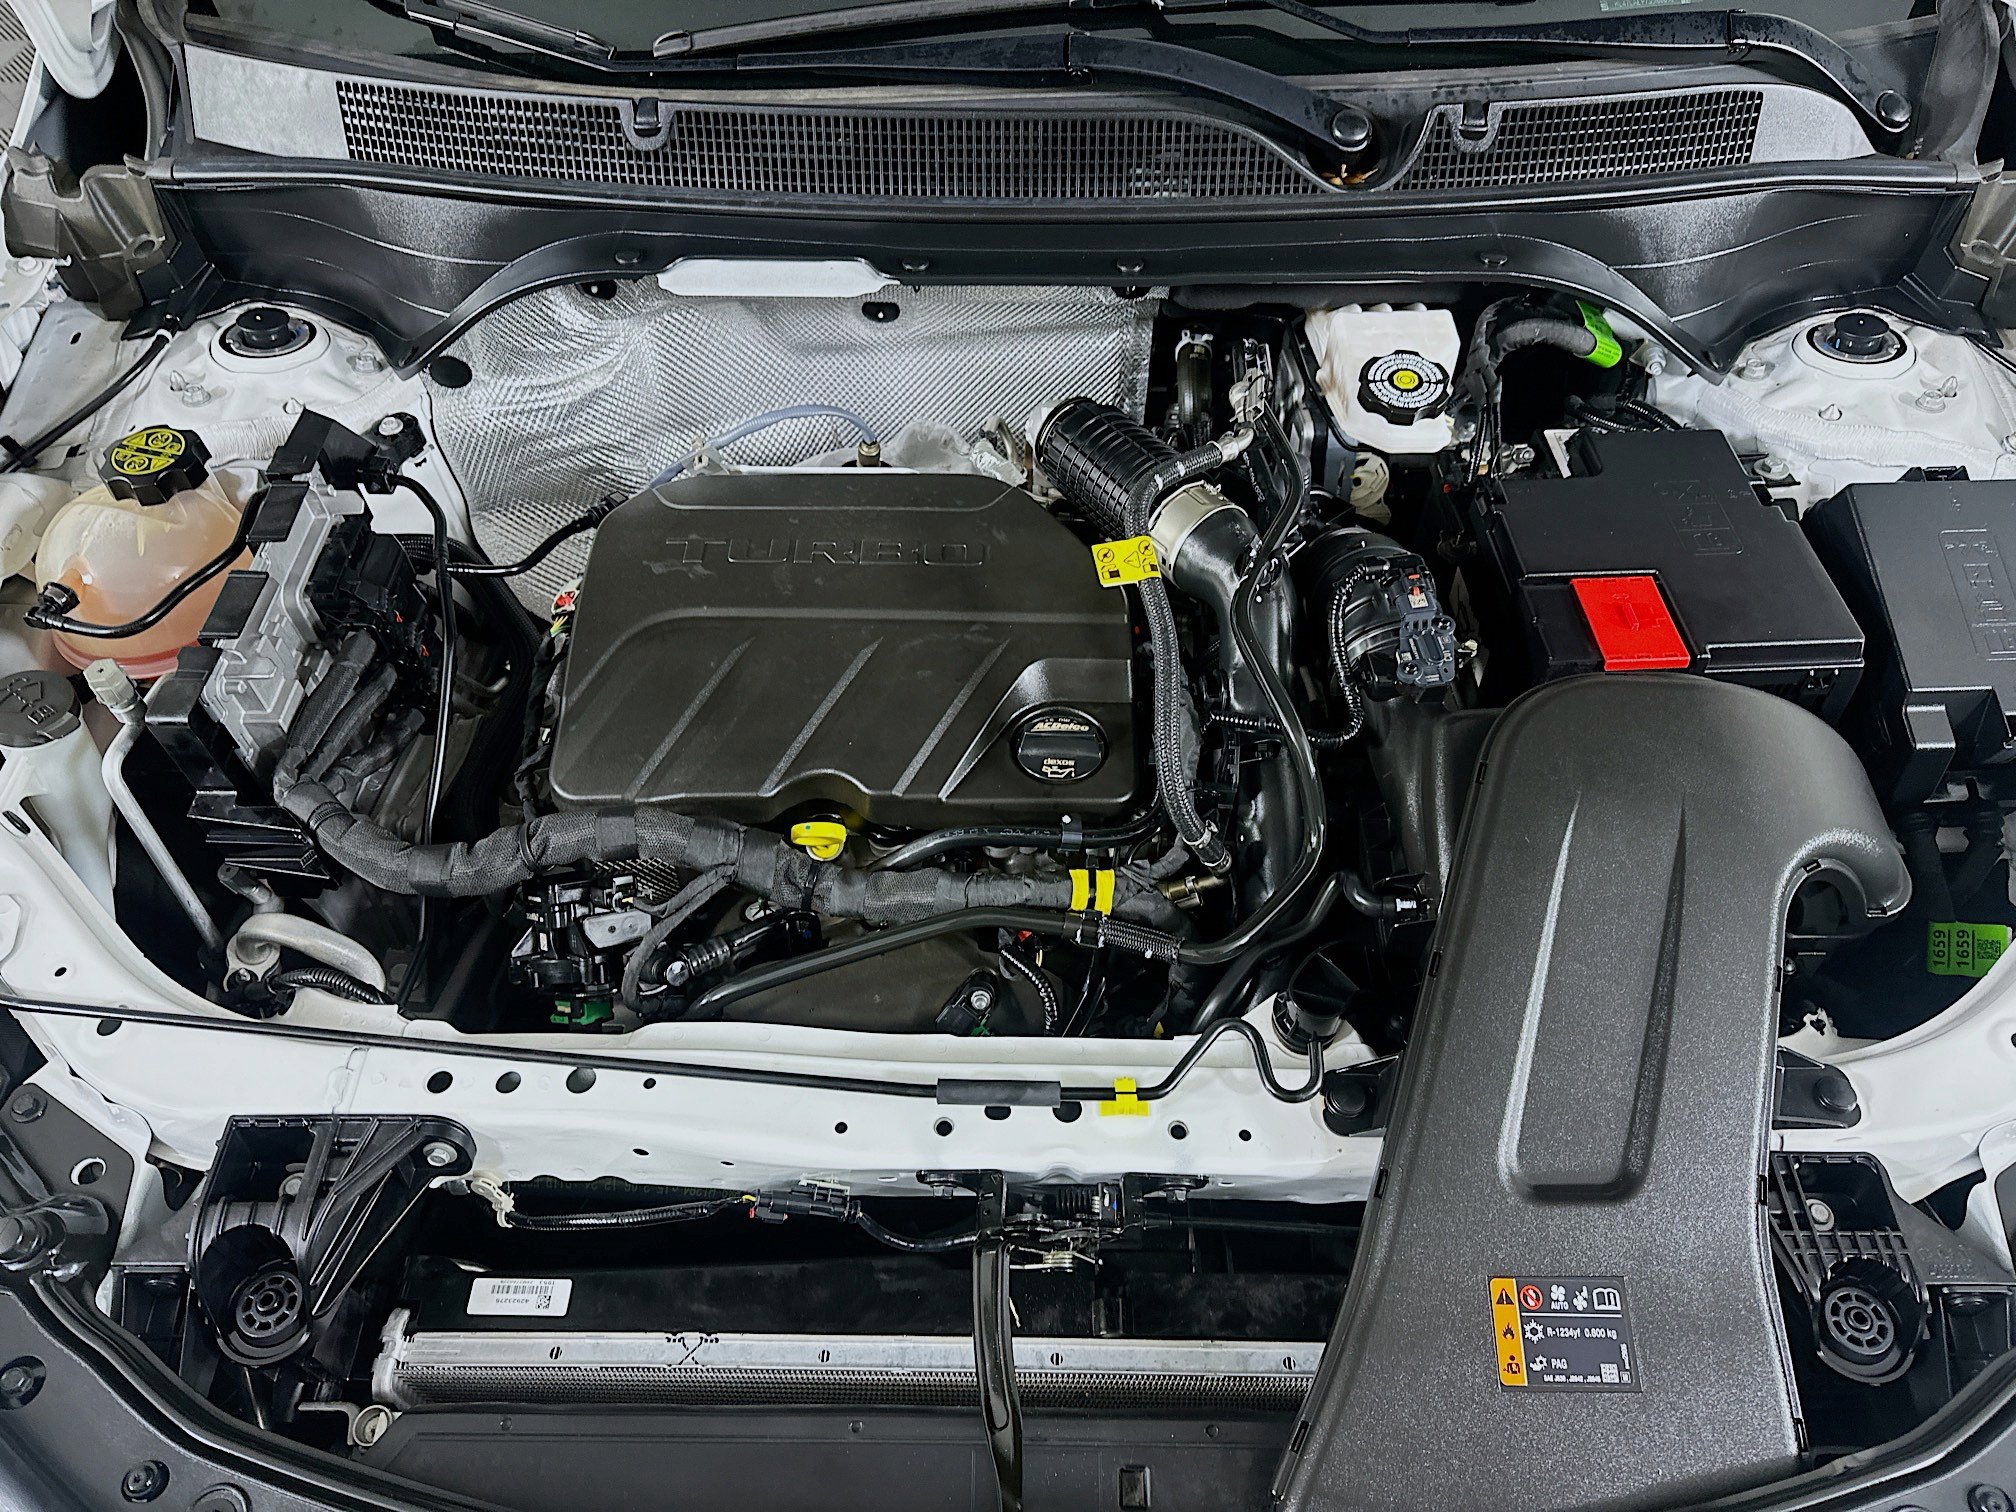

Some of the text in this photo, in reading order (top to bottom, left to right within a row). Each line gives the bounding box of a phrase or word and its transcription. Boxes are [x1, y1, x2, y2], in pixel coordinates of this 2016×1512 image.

[665, 537, 985, 565] TURBO
[1031, 722, 1090, 731] ACDelco
[1043, 757, 1076, 766] dexos
[1932, 929, 1946, 967] 1659
[1956, 929, 1970, 968] 1659
[1551, 1301, 1569, 1310] AUTO
[1606, 1328, 1618, 1340] kg
[1551, 1358, 1568, 1369] PAG
